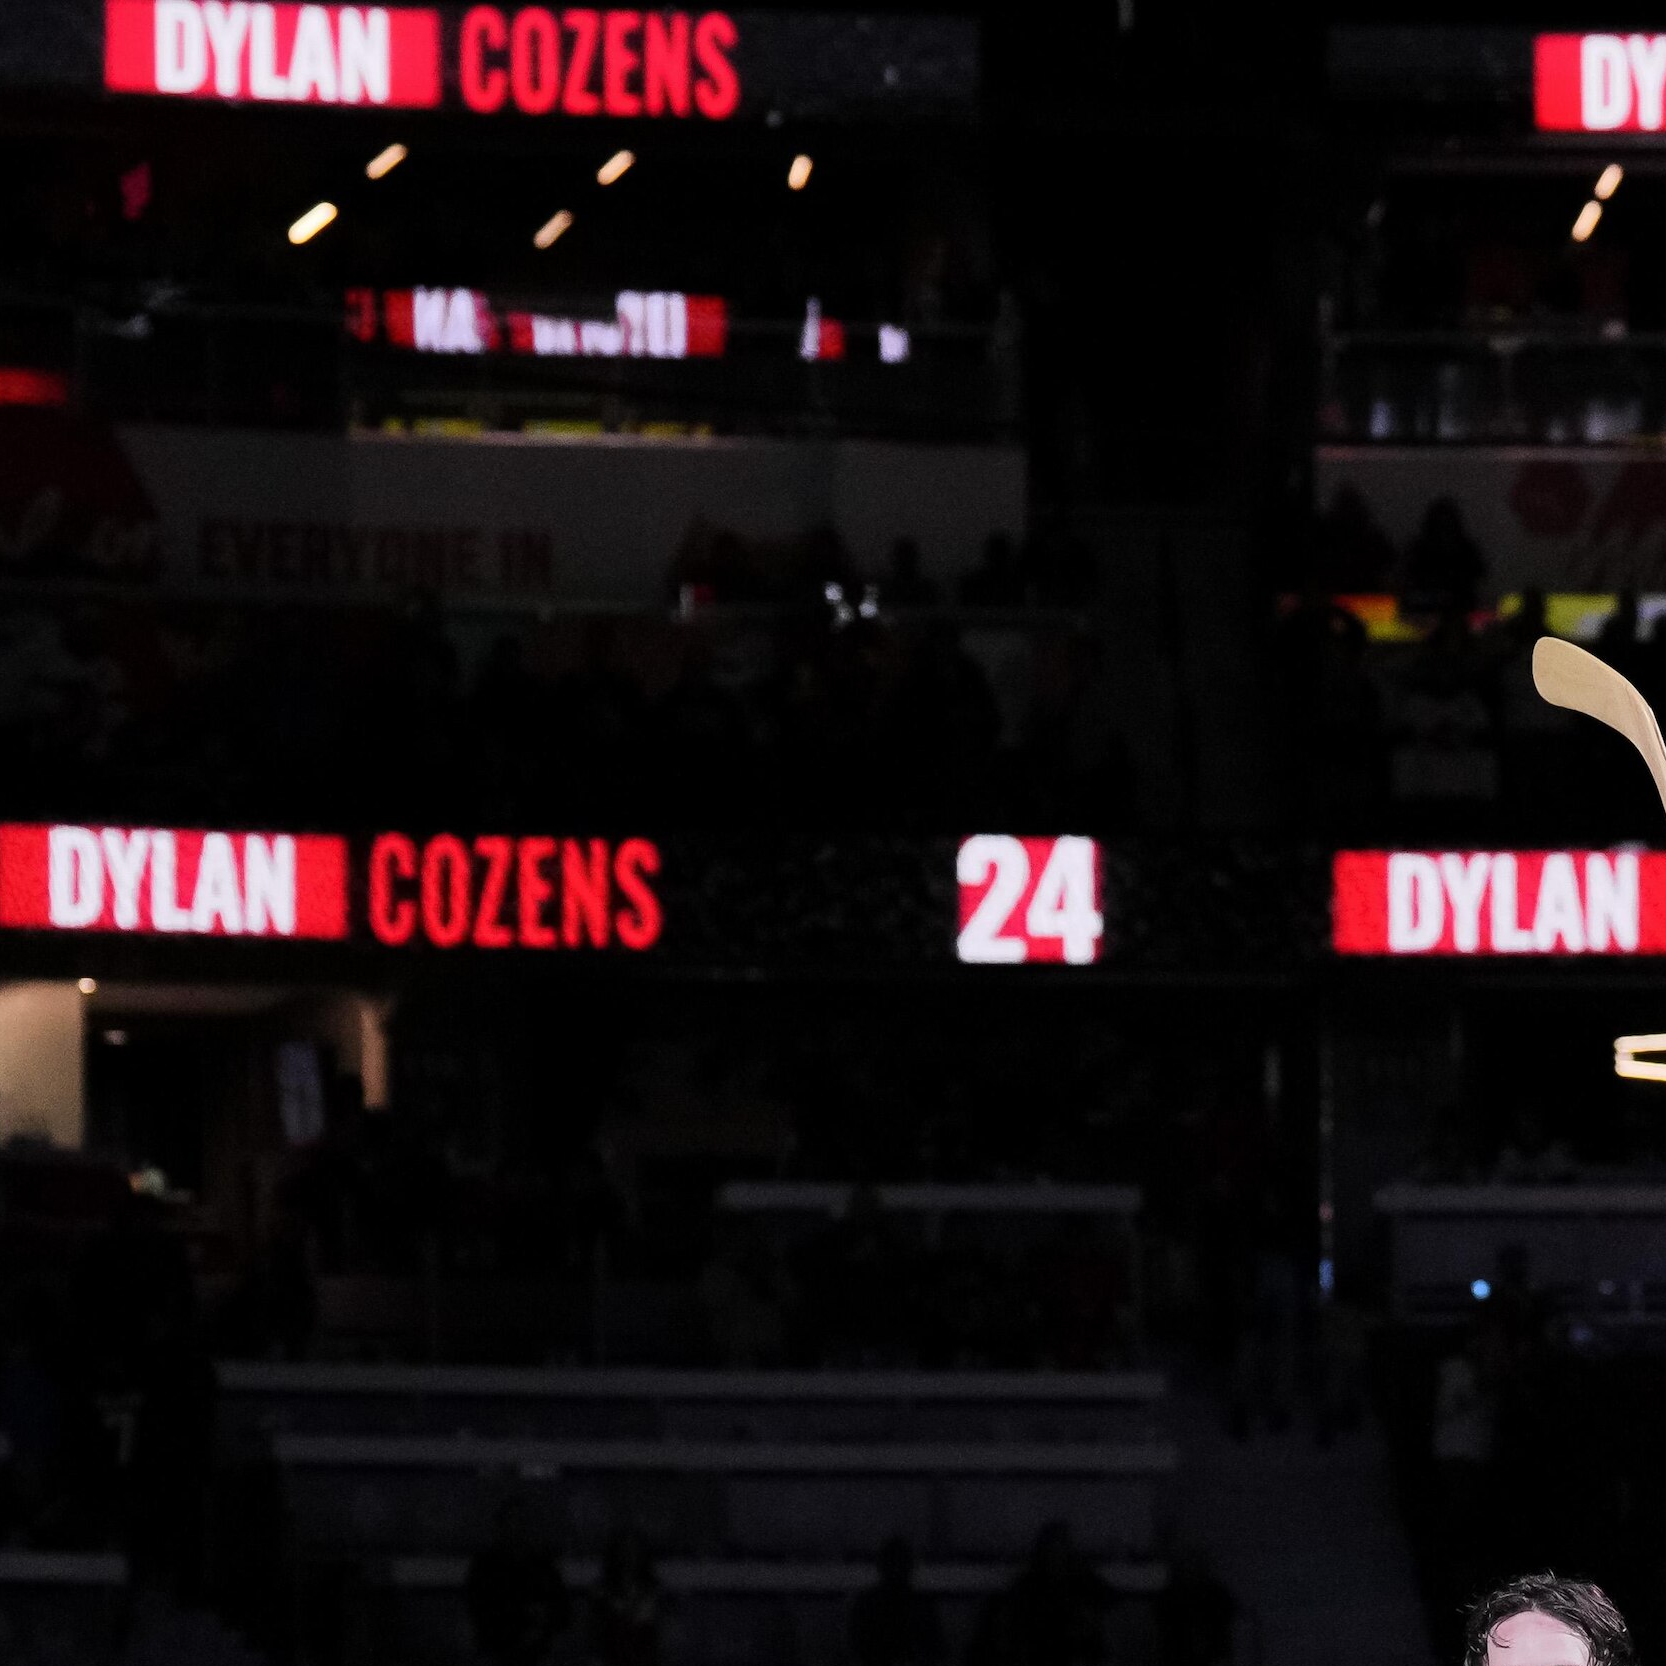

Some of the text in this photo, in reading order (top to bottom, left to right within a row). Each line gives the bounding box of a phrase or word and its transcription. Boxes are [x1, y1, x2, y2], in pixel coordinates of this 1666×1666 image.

[154, 0, 739, 119] DYLAN COZENS
[48, 825, 662, 950] DYLAN COZENS
[956, 834, 1103, 964] 24
[1388, 851, 1639, 952] DYLAN
